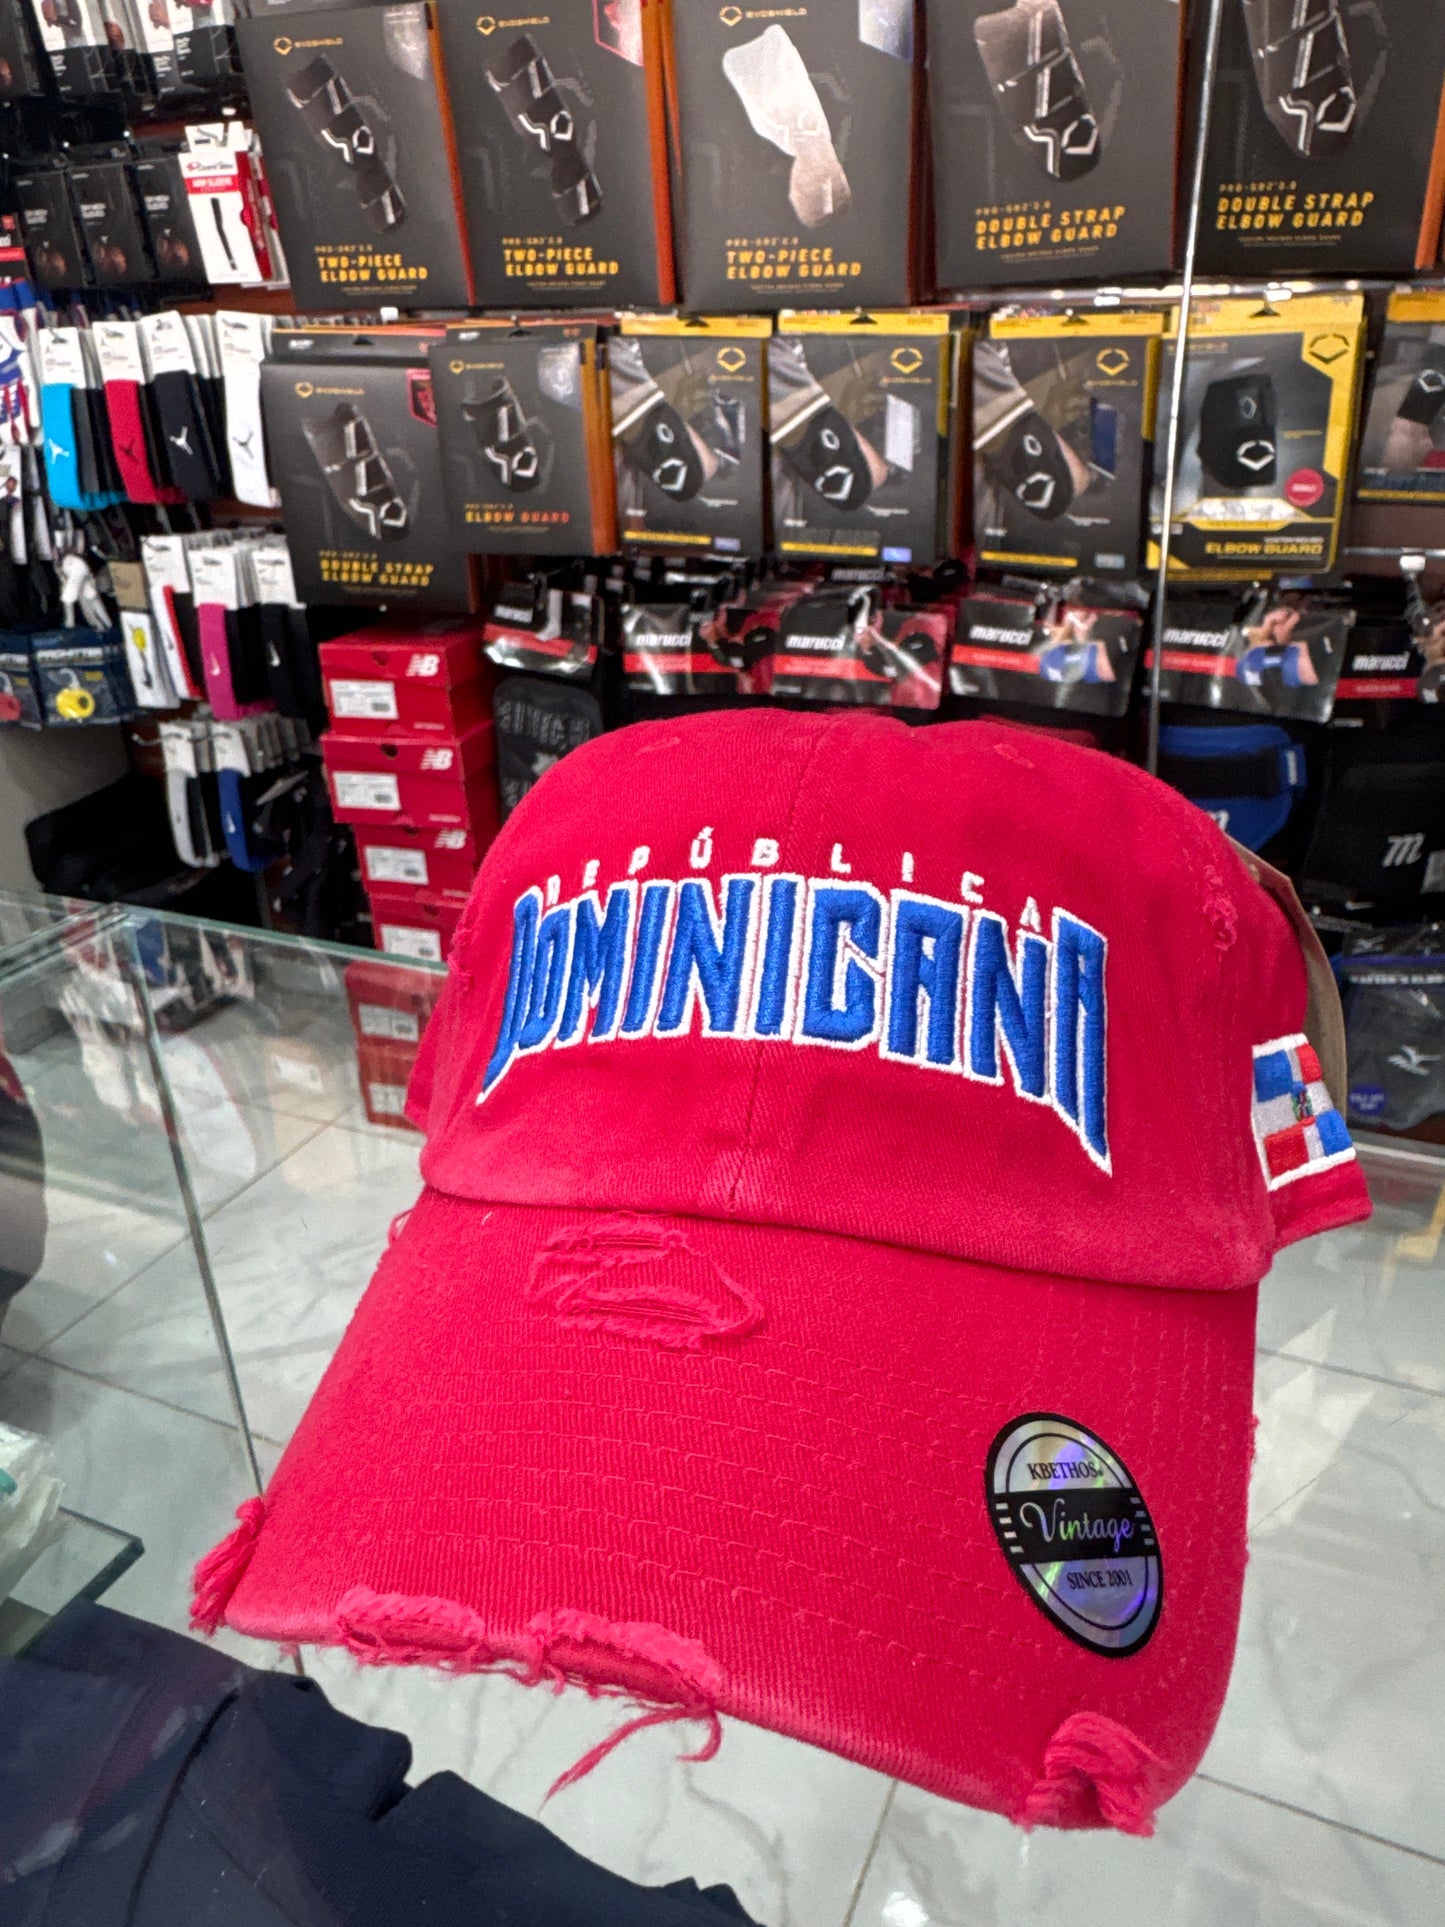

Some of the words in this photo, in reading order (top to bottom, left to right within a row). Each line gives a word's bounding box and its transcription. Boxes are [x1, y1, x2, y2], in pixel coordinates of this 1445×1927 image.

[1217, 194, 1296, 213] DOUBLE
[1303, 191, 1374, 210] STRAP
[976, 213, 1051, 234] DOUBLE
[1060, 206, 1125, 226] STRAP
[1216, 213, 1284, 230] ELBOW
[1292, 210, 1364, 229] GUARD
[976, 230, 1042, 250] ELBOW
[1051, 222, 1117, 243] GUARD
[317, 253, 403, 269] TWO-PIECE
[504, 246, 593, 262] TWO-PIECE
[726, 247, 833, 264] TWO-PIECE
[321, 268, 370, 283] ELBOW
[376, 266, 428, 281] GUARD
[505, 262, 559, 277] ELBOW
[565, 260, 619, 276] GUARD
[726, 264, 791, 280] ELBOW
[798, 261, 862, 278] GUARD
[465, 511, 515, 523] ELBOW
[520, 511, 570, 524] GUARD
[1205, 541, 1262, 555] ELBOW
[1264, 542, 1324, 555] GUARD
[320, 559, 378, 573] DOUBLE
[385, 561, 434, 575] STRAP
[322, 572, 373, 583] ELBOW
[379, 573, 430, 587] GUARD
[635, 631, 692, 648] marucci
[785, 633, 847, 651] marucci
[969, 624, 1034, 646] marucci
[1163, 627, 1231, 649] marucci
[1351, 651, 1411, 672] marucci
[546, 826, 1042, 933] REPÚBLICA
[475, 873, 1112, 1177] DOMINICANA
[1027, 1461, 1099, 1480] KBETHOS
[1020, 1498, 1134, 1553] Vintage
[1066, 1570, 1107, 1590] SINCE
[1107, 1569, 1134, 1587] 2001
